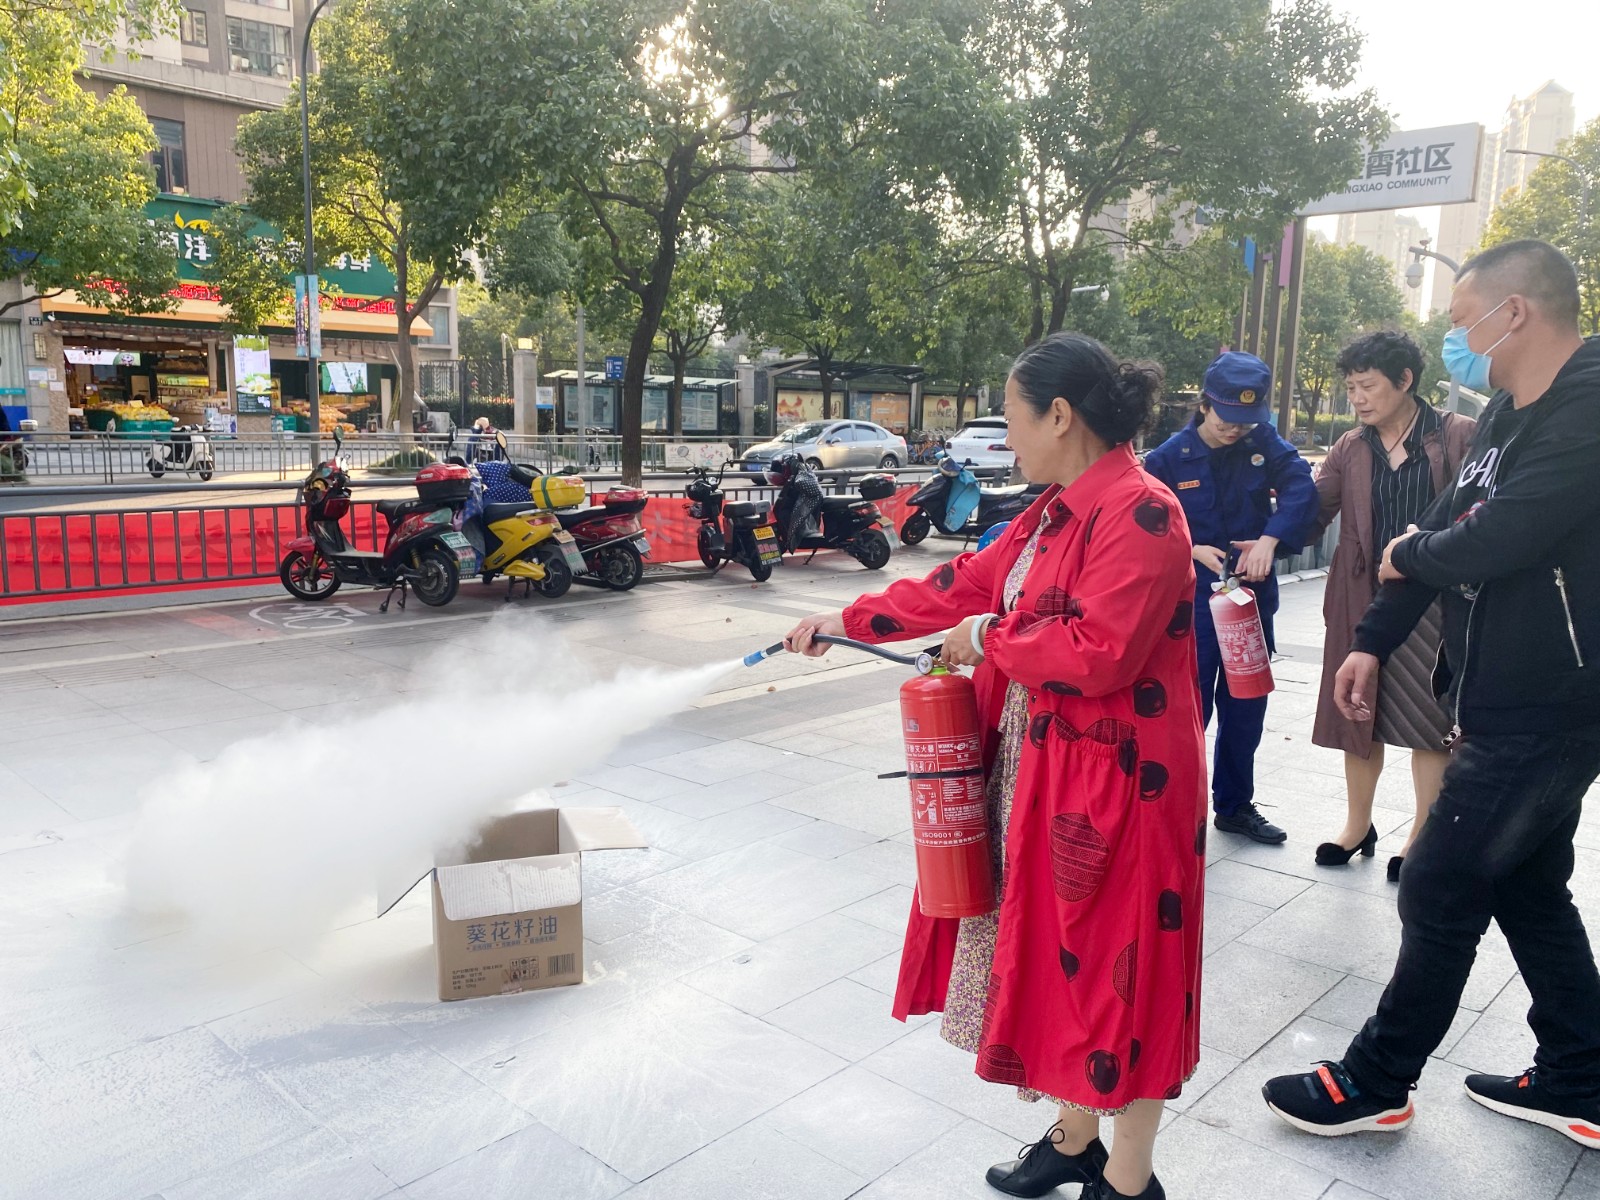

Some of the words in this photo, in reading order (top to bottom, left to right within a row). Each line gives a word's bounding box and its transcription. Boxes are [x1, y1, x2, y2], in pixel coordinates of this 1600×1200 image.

[1344, 182, 1383, 194] NGXIAO
[1387, 175, 1451, 189] COMMUNITY
[466, 915, 558, 945] 葵花籽油
